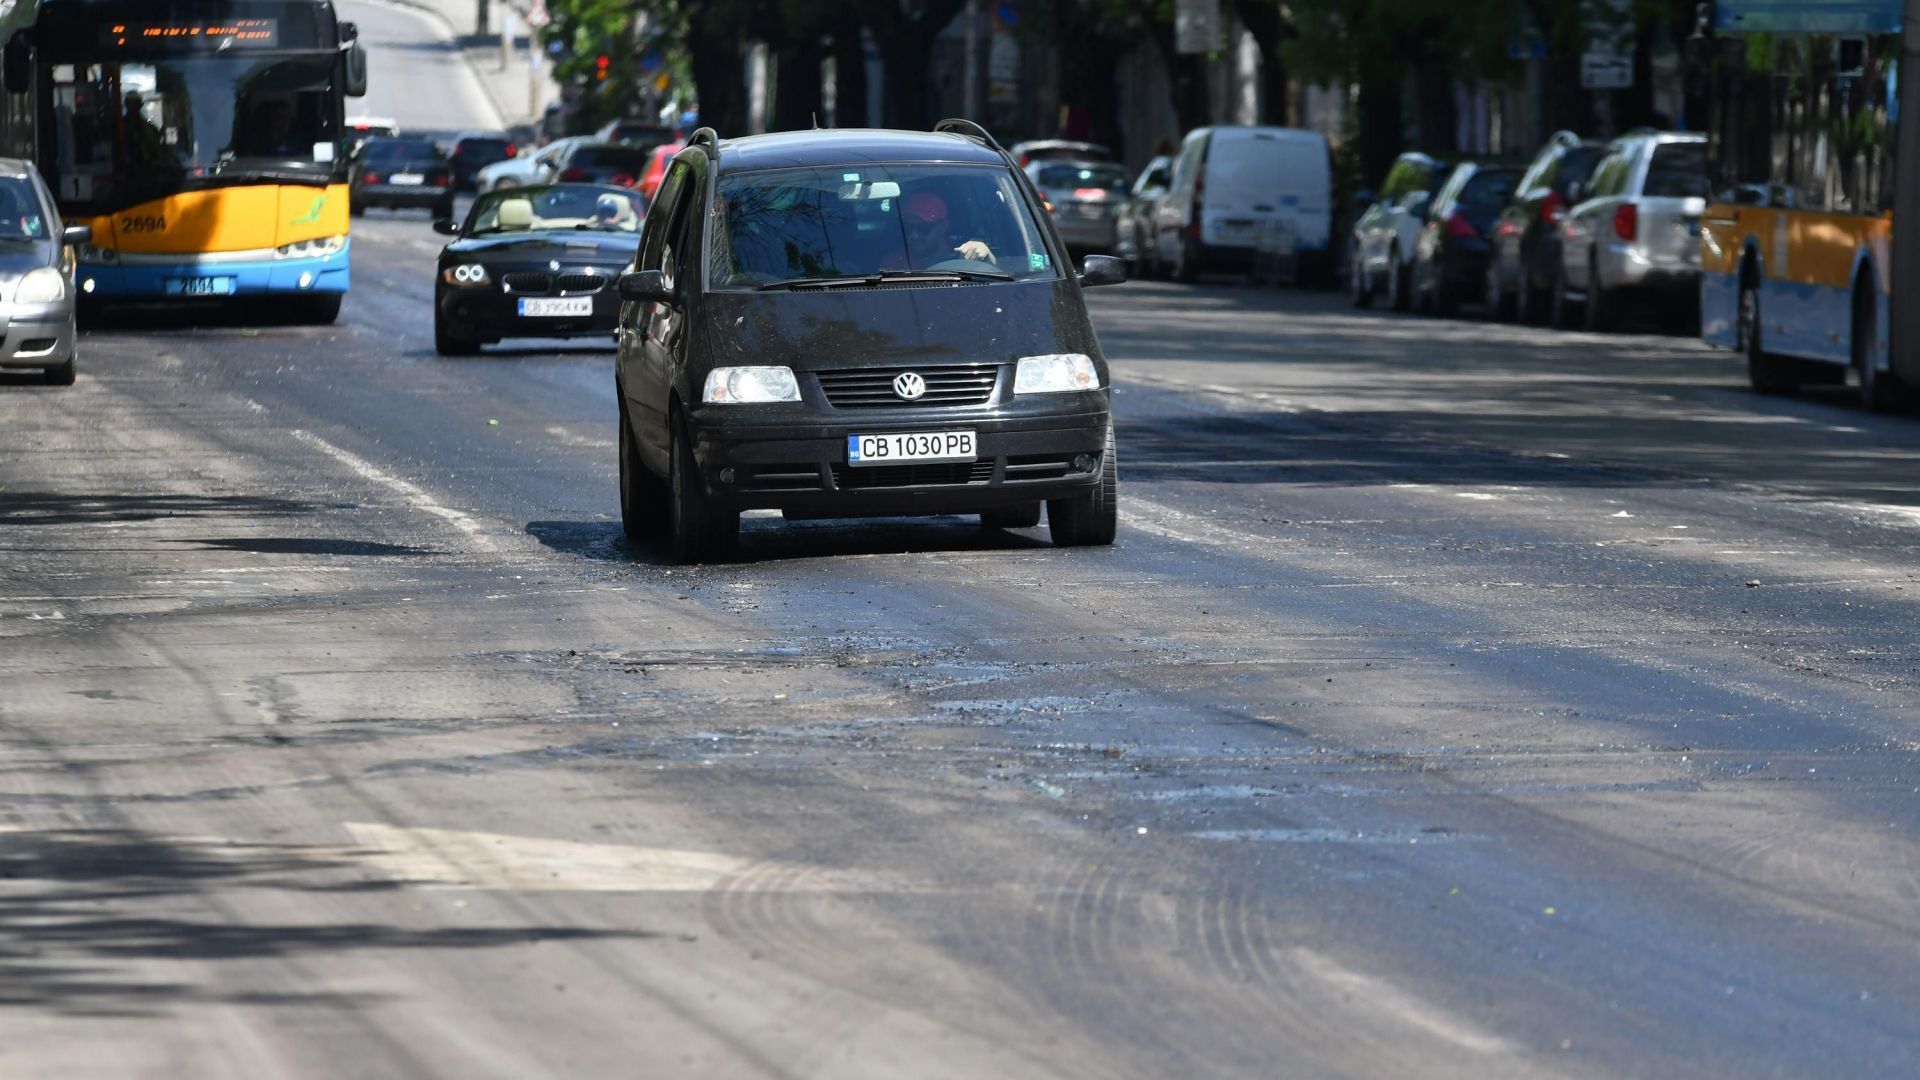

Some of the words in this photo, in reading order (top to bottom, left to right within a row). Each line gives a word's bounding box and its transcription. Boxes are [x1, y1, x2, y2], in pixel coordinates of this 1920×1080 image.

[121, 215, 166, 233] 2694
[180, 277, 214, 295] 2694
[863, 438, 889, 457] CB
[895, 436, 942, 456] 1030
[946, 434, 972, 454] PB
